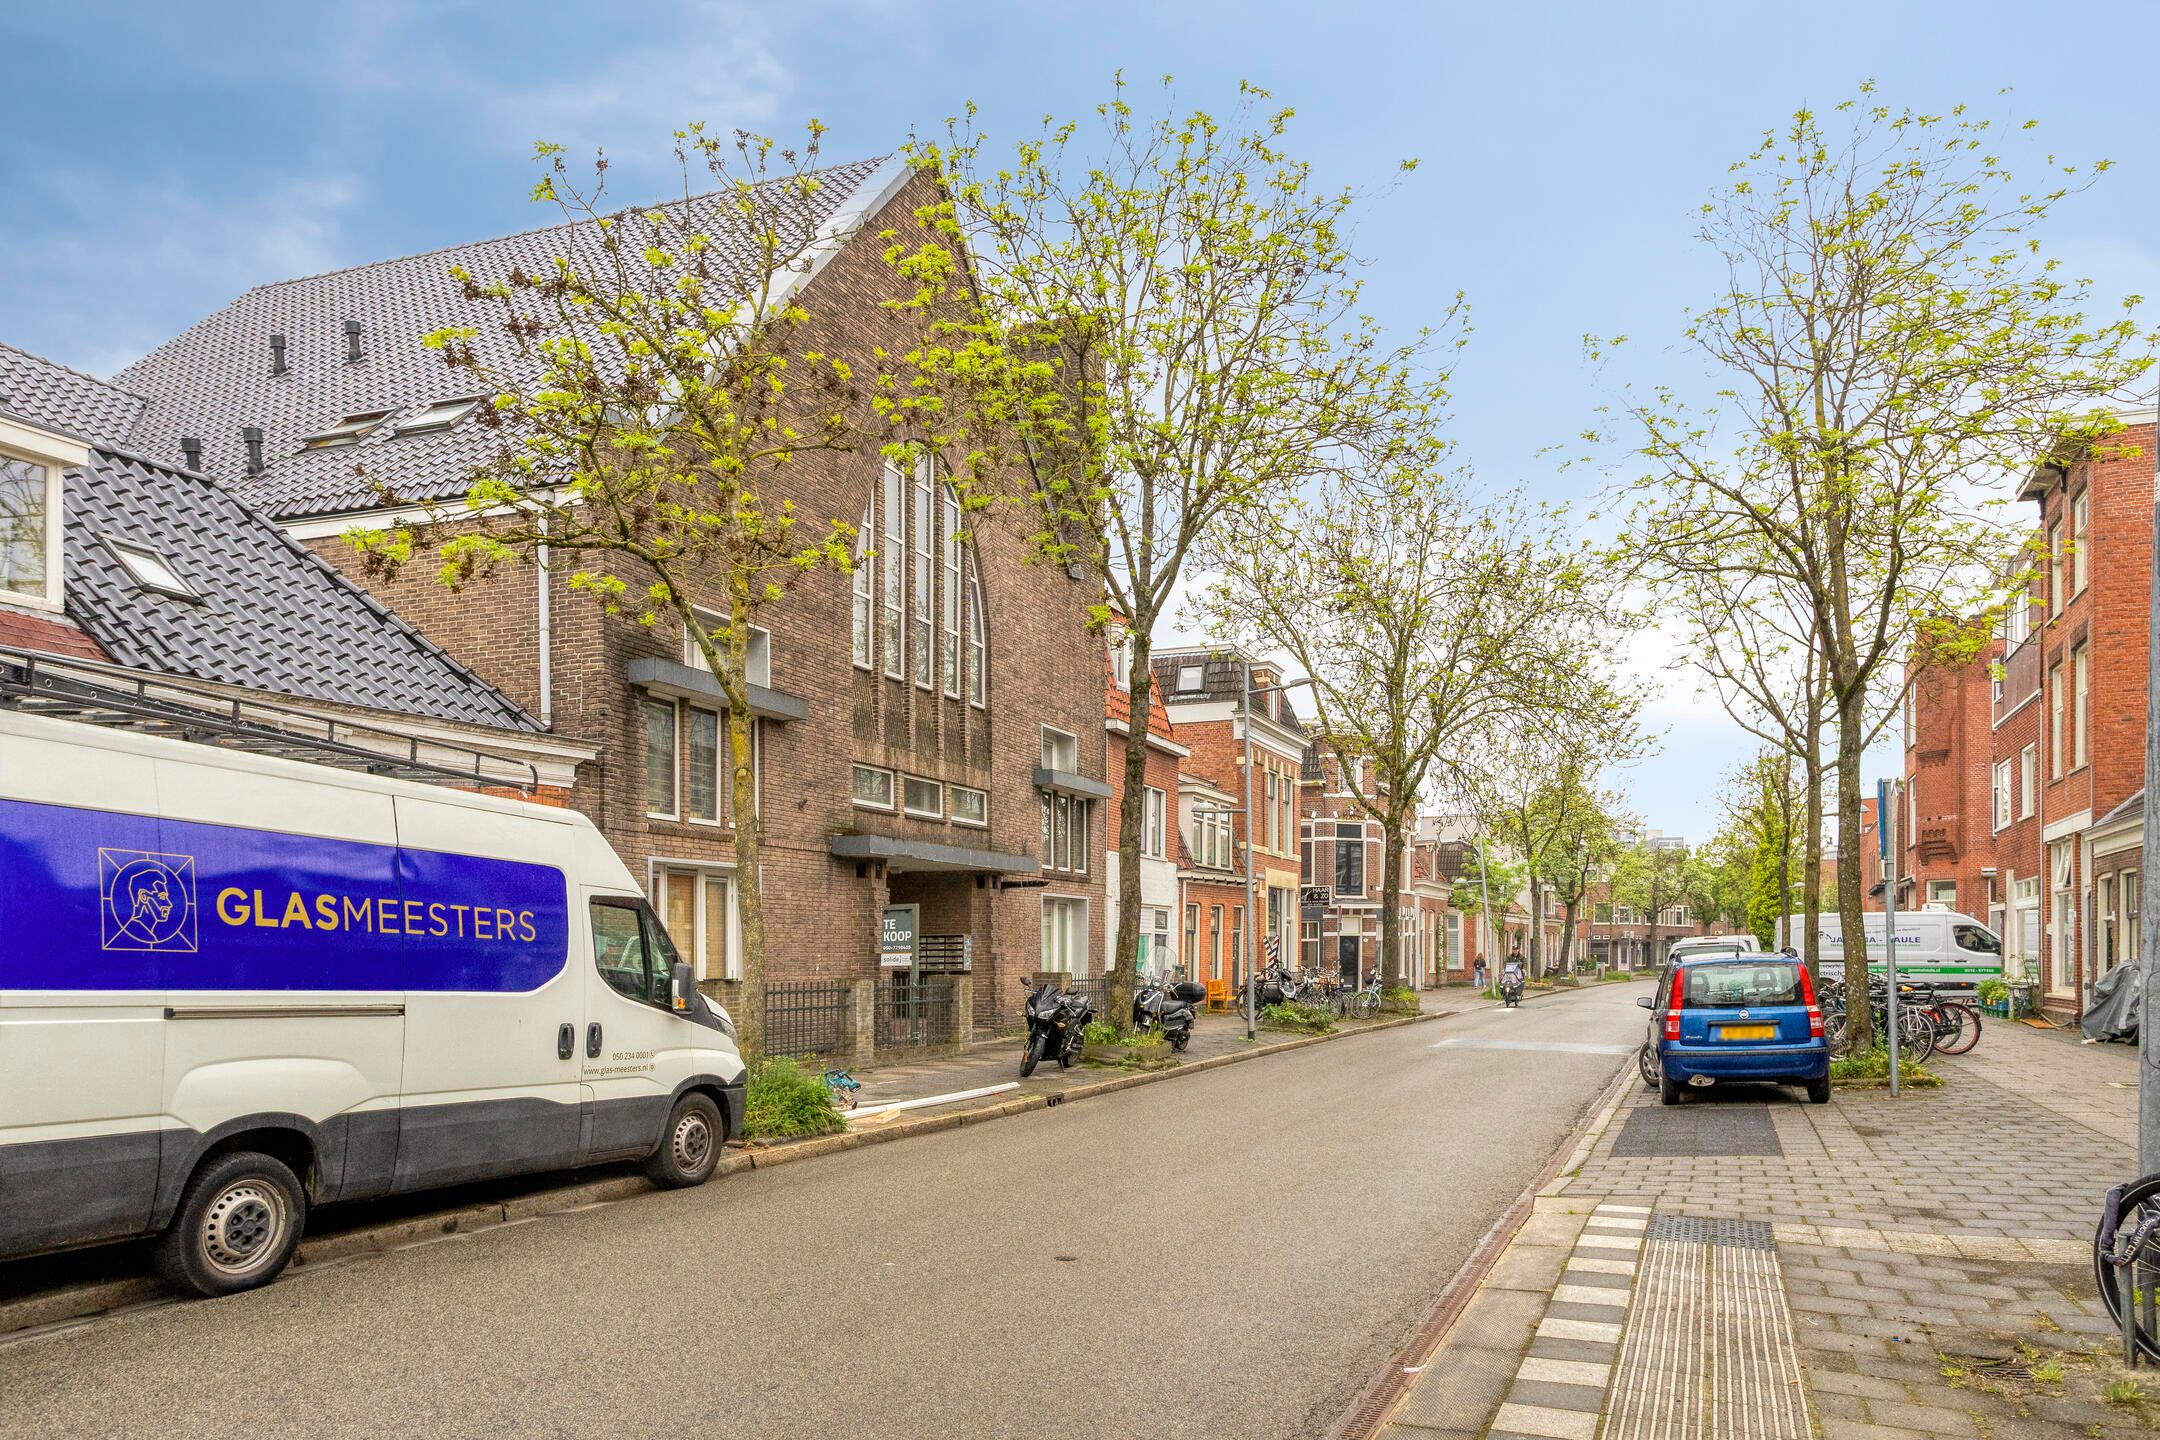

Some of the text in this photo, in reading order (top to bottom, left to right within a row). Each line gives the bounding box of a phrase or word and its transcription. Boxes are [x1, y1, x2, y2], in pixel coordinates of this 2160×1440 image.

[216, 887, 537, 942] GLASMEESTERS
[883, 919, 896, 930] TE
[883, 931, 912, 942] KOOP
[612, 1051, 649, 1061] 050 234 0001
[583, 1063, 649, 1076] www.glas-meesters.nl
